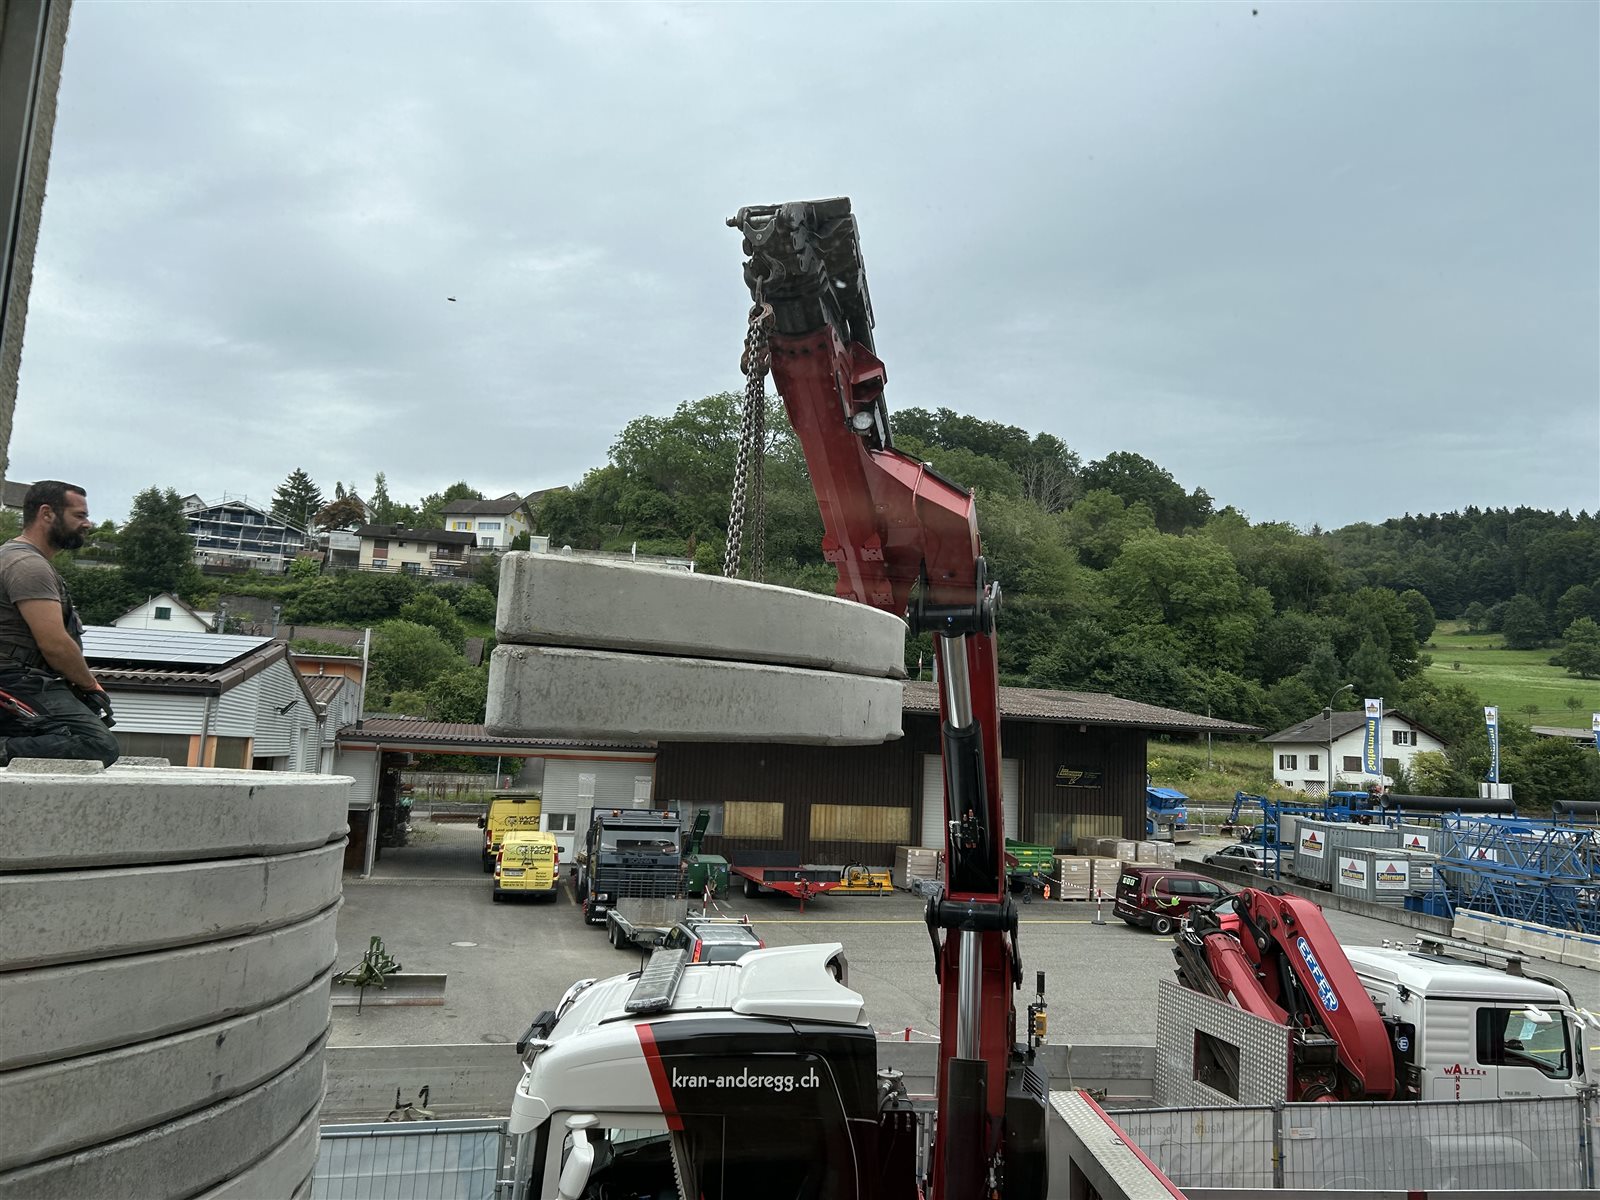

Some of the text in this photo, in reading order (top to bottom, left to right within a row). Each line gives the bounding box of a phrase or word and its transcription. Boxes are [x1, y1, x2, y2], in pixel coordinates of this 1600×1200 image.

[1343, 870, 1364, 880] Soltermann
[1378, 873, 1405, 882] Soltermann
[1298, 939, 1338, 1010] EFFER
[1444, 1063, 1487, 1076] WALTER
[672, 1067, 820, 1092] kran-anderegg.ch
